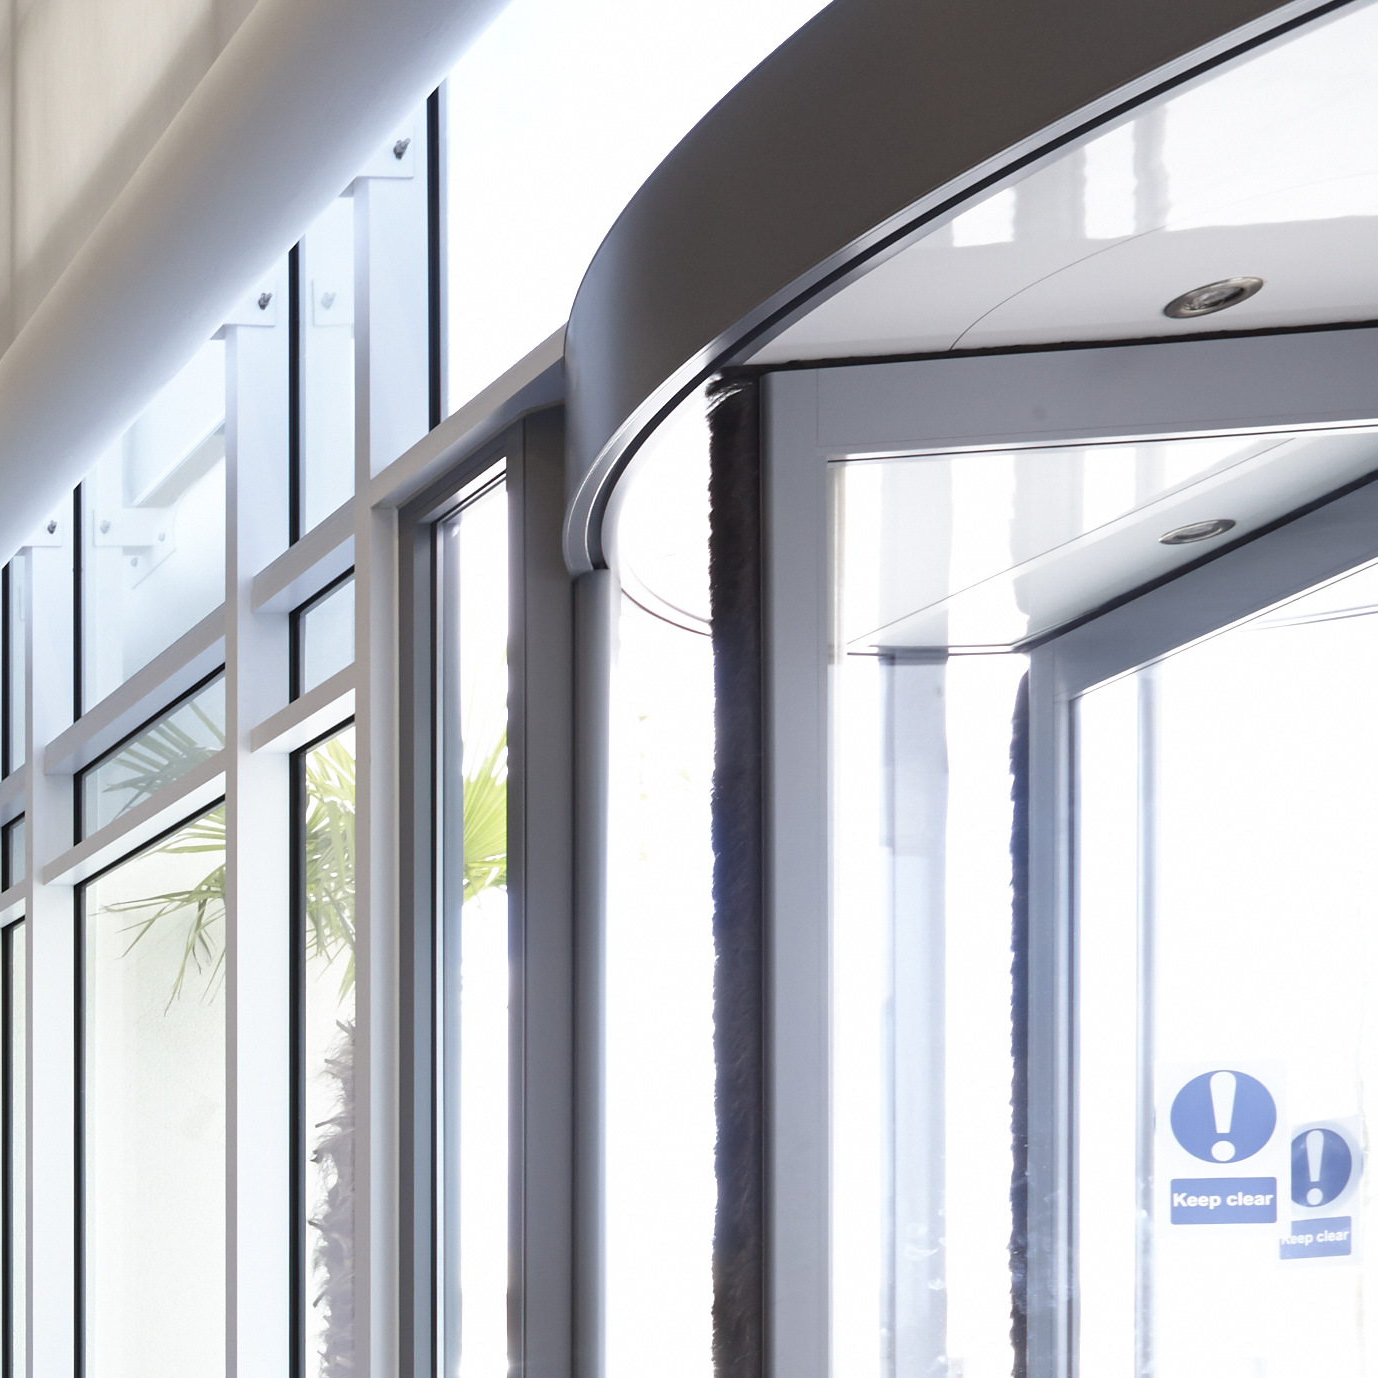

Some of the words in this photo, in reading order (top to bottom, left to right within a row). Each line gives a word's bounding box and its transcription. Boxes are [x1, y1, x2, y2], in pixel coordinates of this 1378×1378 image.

[1173, 1192, 1221, 1209] Keep
[1226, 1192, 1274, 1206] clear
[1316, 1230, 1350, 1242] clear
